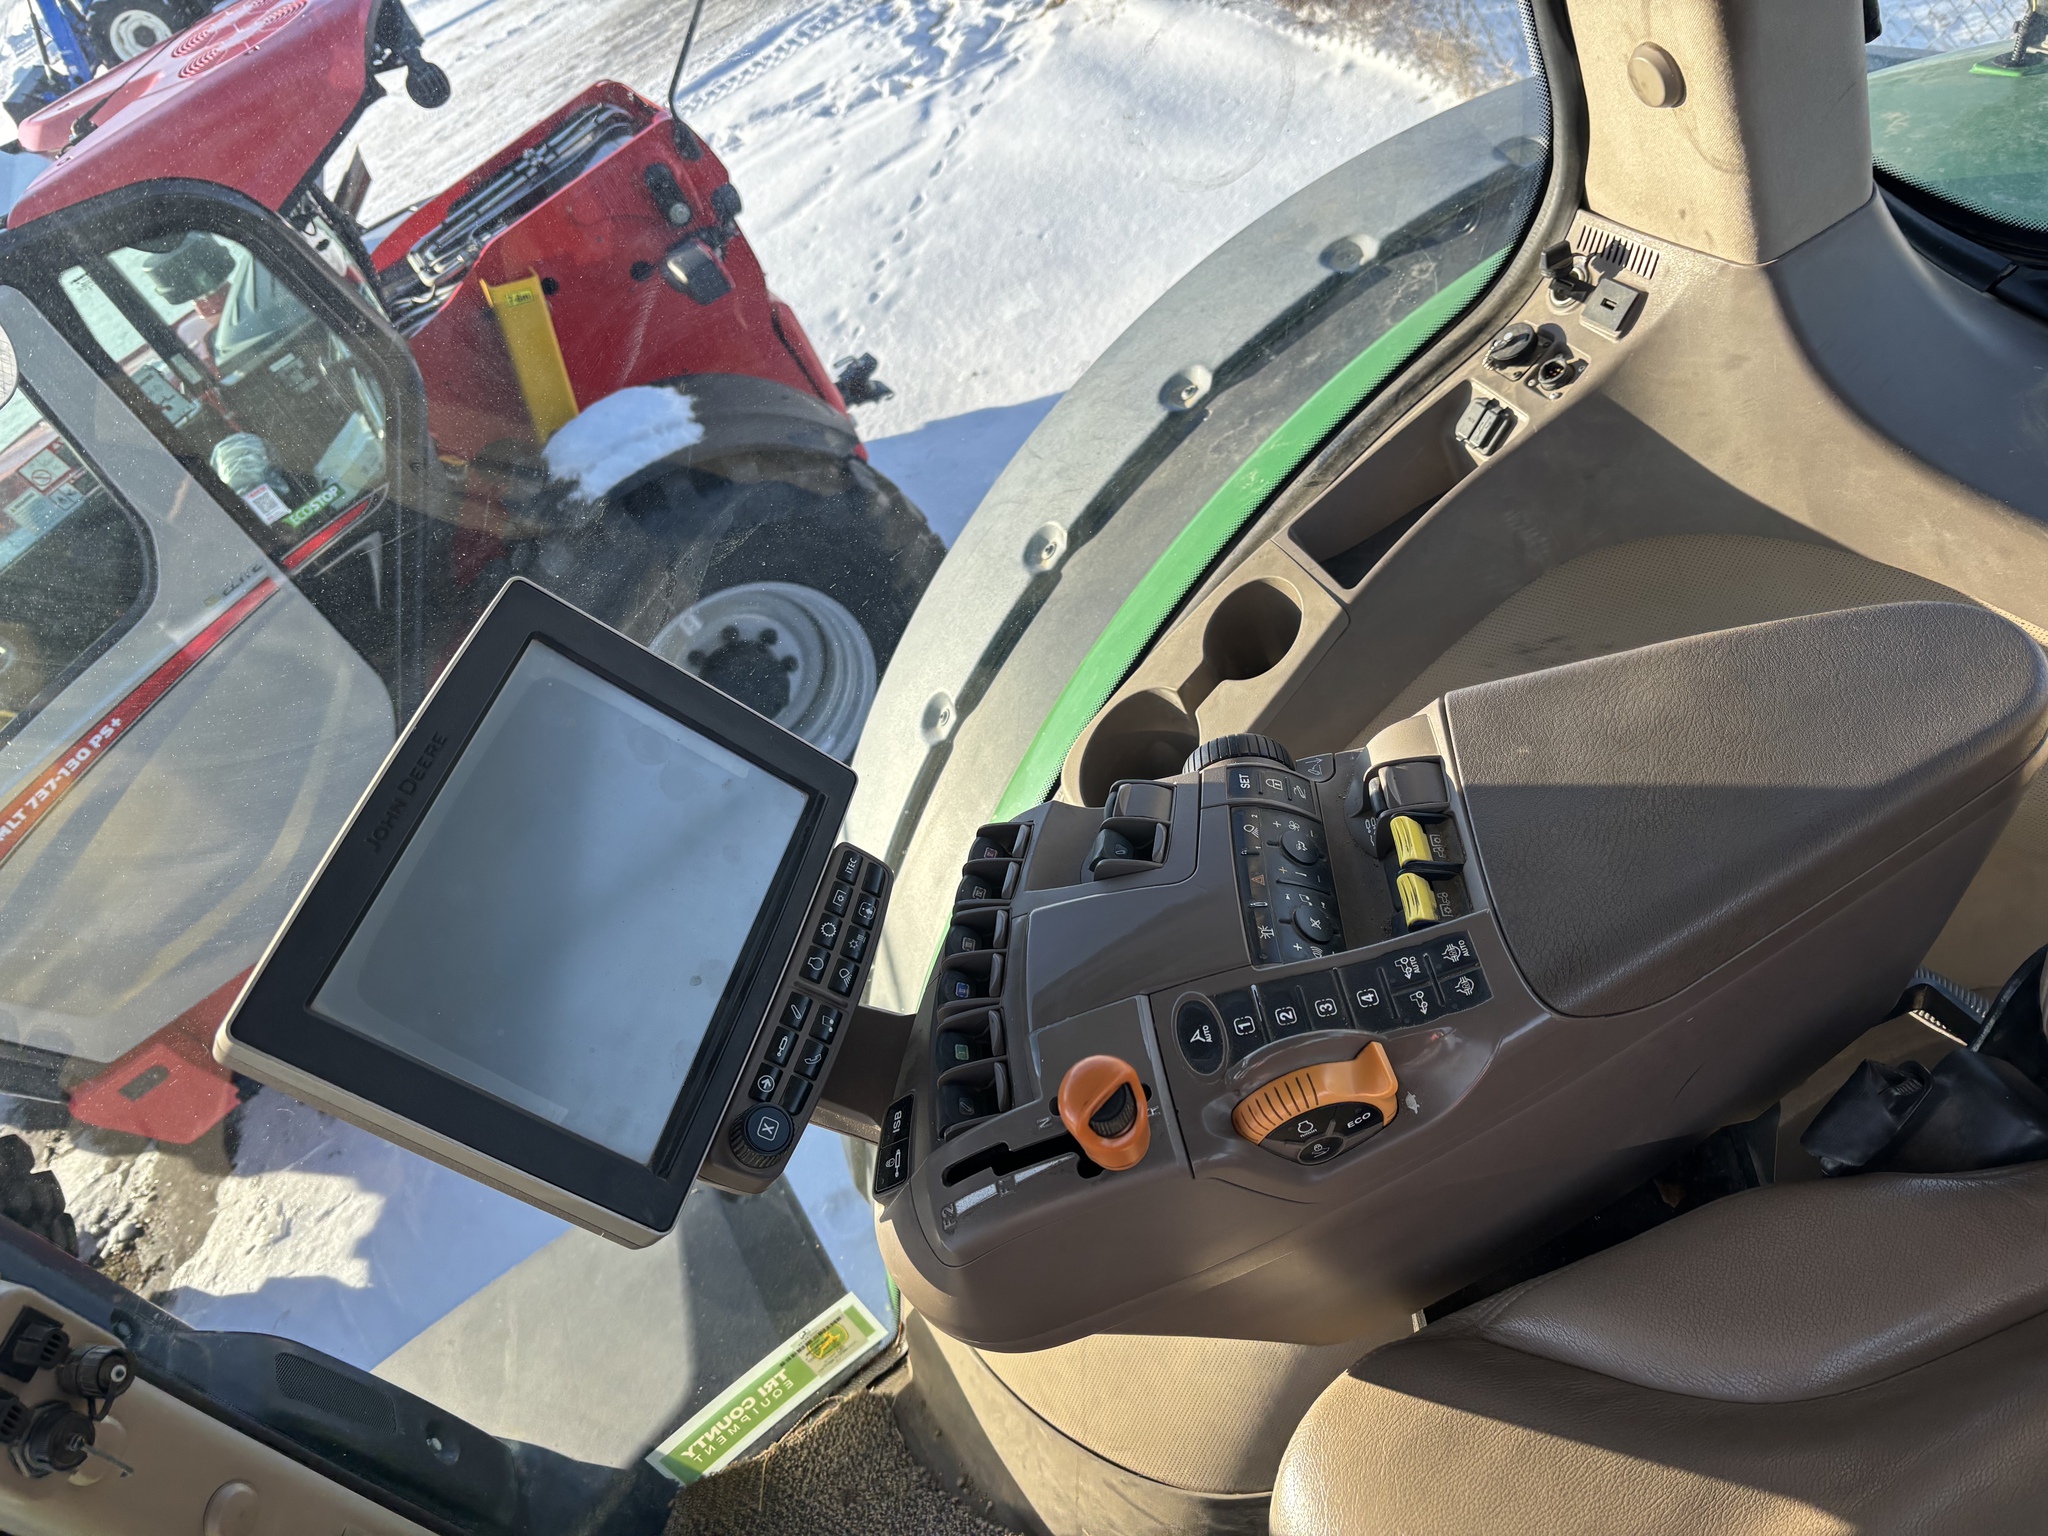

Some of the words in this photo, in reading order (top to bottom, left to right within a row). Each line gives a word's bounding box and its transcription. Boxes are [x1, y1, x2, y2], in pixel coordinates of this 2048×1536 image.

[289, 485, 338, 525] ECOSTOP
[0, 808, 27, 840] MLT
[24, 747, 92, 810] 737-130
[88, 717, 122, 748] PS+
[1239, 774, 1251, 789] SET
[364, 798, 407, 853] JOHN
[397, 731, 449, 797] DEERE
[844, 857, 858, 875] iTEC
[1458, 939, 1471, 957] AUTO
[1409, 956, 1421, 974] AUTO
[1360, 992, 1375, 1002] 4
[1279, 1010, 1294, 1021] 2
[1319, 1002, 1333, 1013] 3
[1202, 1025, 1213, 1043] AUTO
[1237, 1021, 1251, 1030] 1
[892, 1110, 903, 1133] ISB
[1036, 1116, 1052, 1129] N
[1346, 1112, 1371, 1129] ECO
[941, 1202, 957, 1231] F2
